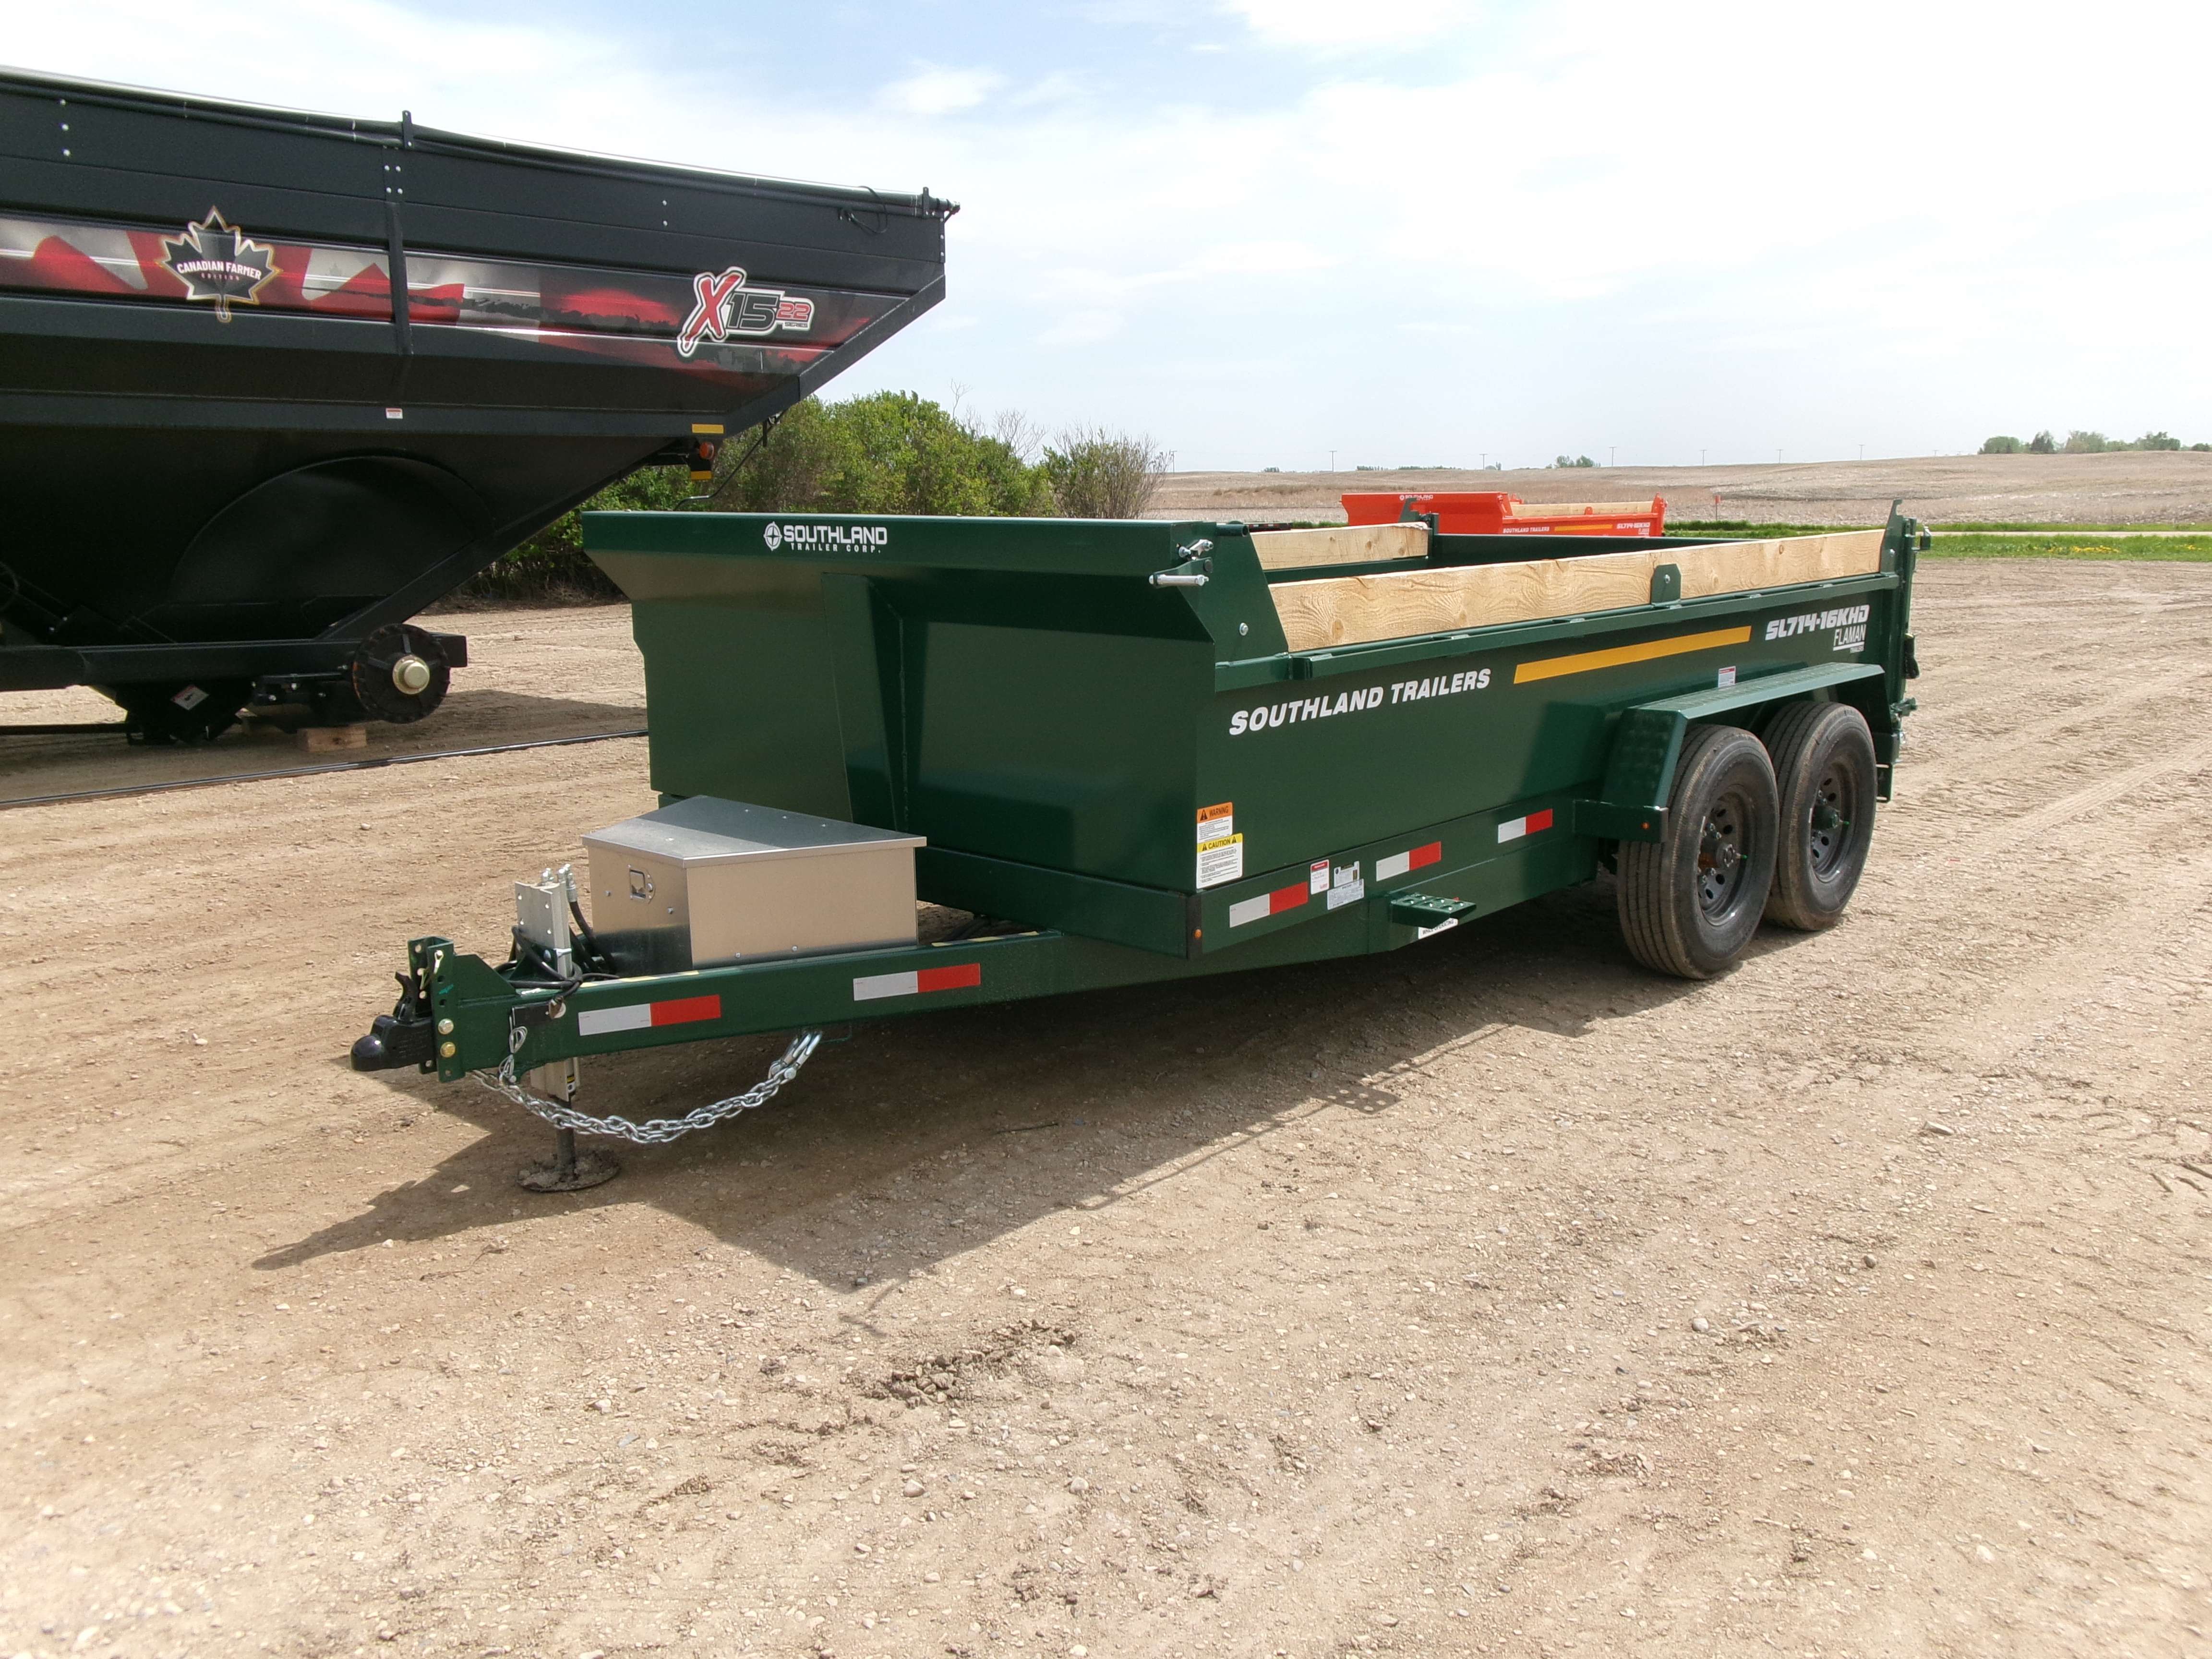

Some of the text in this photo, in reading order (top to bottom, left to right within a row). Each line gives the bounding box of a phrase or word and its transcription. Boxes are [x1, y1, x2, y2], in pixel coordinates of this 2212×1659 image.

[177, 260, 262, 280] CANADIAN FARMER
[777, 302, 810, 321] 22
[783, 525, 888, 545] SOUTHLAND
[791, 543, 881, 553] TRAILER CORP.
[1765, 604, 1870, 641] SL714-16KHD
[1833, 624, 1866, 647] FLAMAN
[1229, 668, 1491, 736] SOUTHLAND TRAILERS
[1209, 806, 1229, 817] WARNING
[1208, 838, 1231, 850] CAUTION
